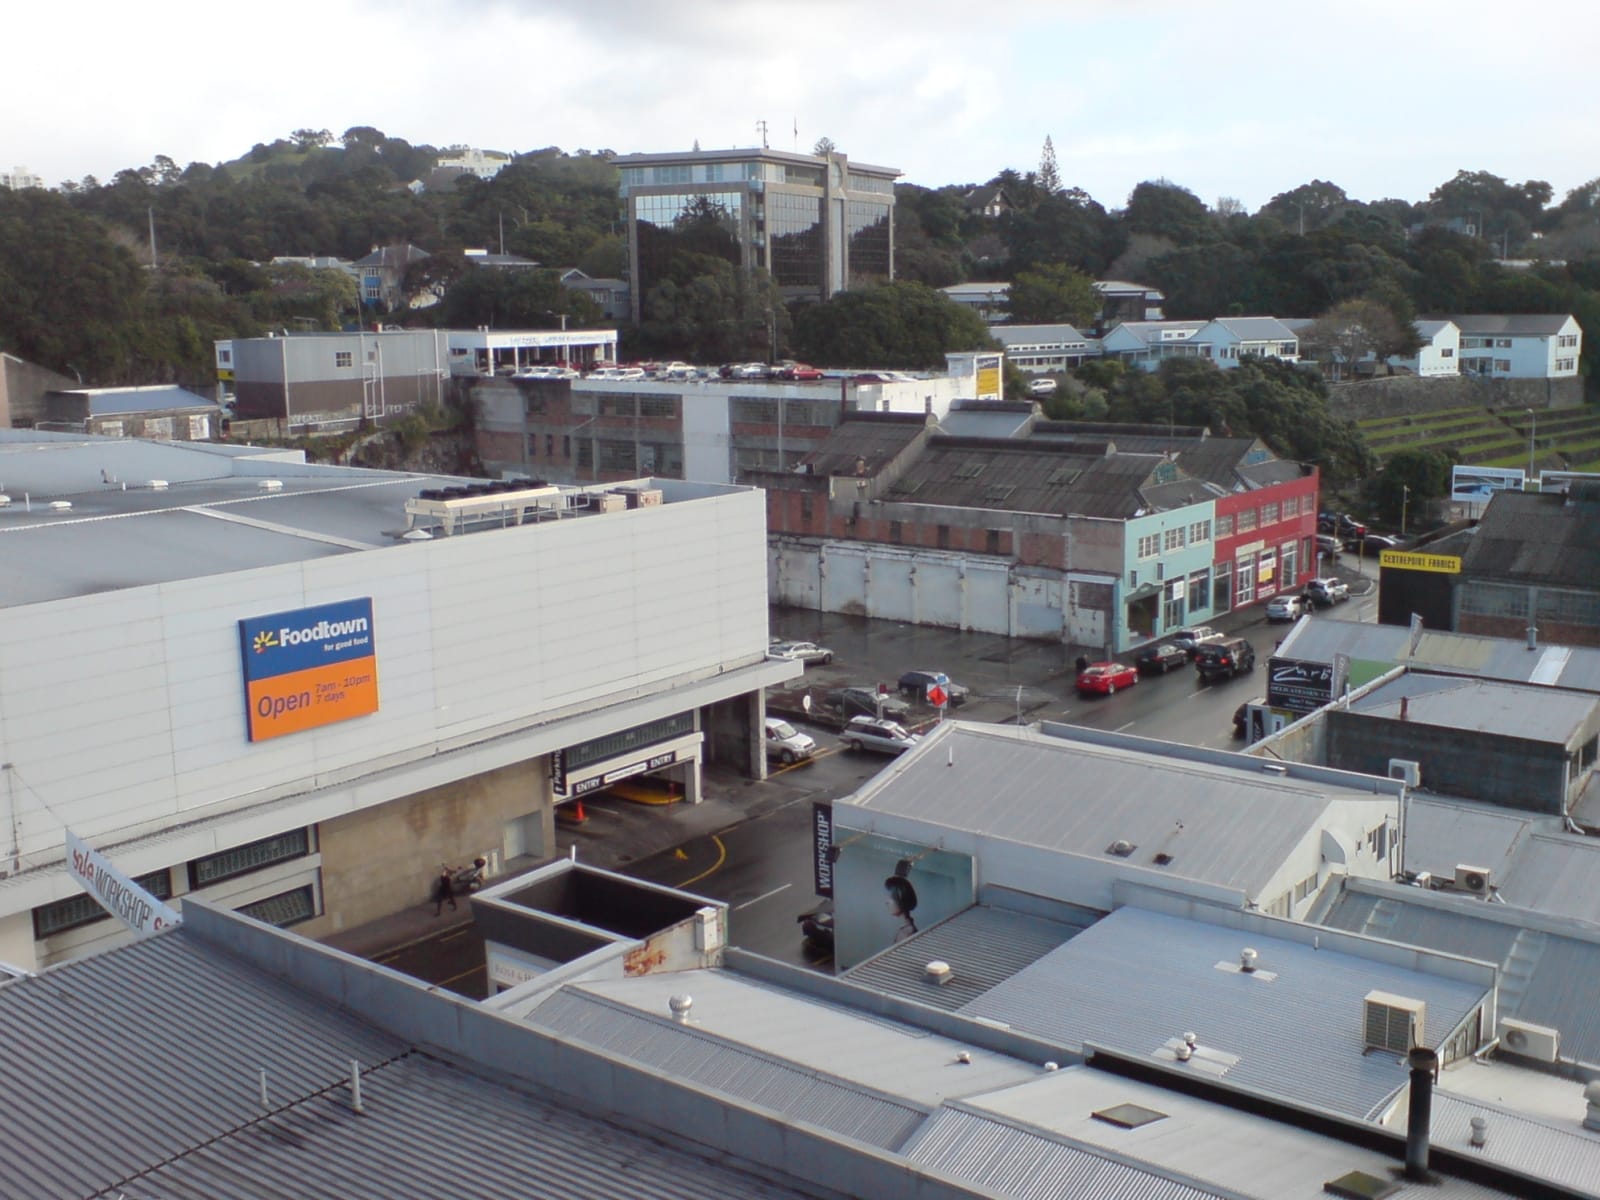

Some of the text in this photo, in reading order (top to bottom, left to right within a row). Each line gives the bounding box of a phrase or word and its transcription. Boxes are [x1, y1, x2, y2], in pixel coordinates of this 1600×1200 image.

[280, 617, 367, 647] Foodtown
[324, 636, 368, 651] for good food
[1273, 665, 1332, 682] Zarb
[258, 691, 310, 720] Open
[324, 691, 345, 703] days
[650, 754, 673, 768] ENTRY
[576, 777, 600, 793] ENTRY
[817, 811, 832, 889] WORKSHOP
[95, 866, 150, 931] WORKSHOP
